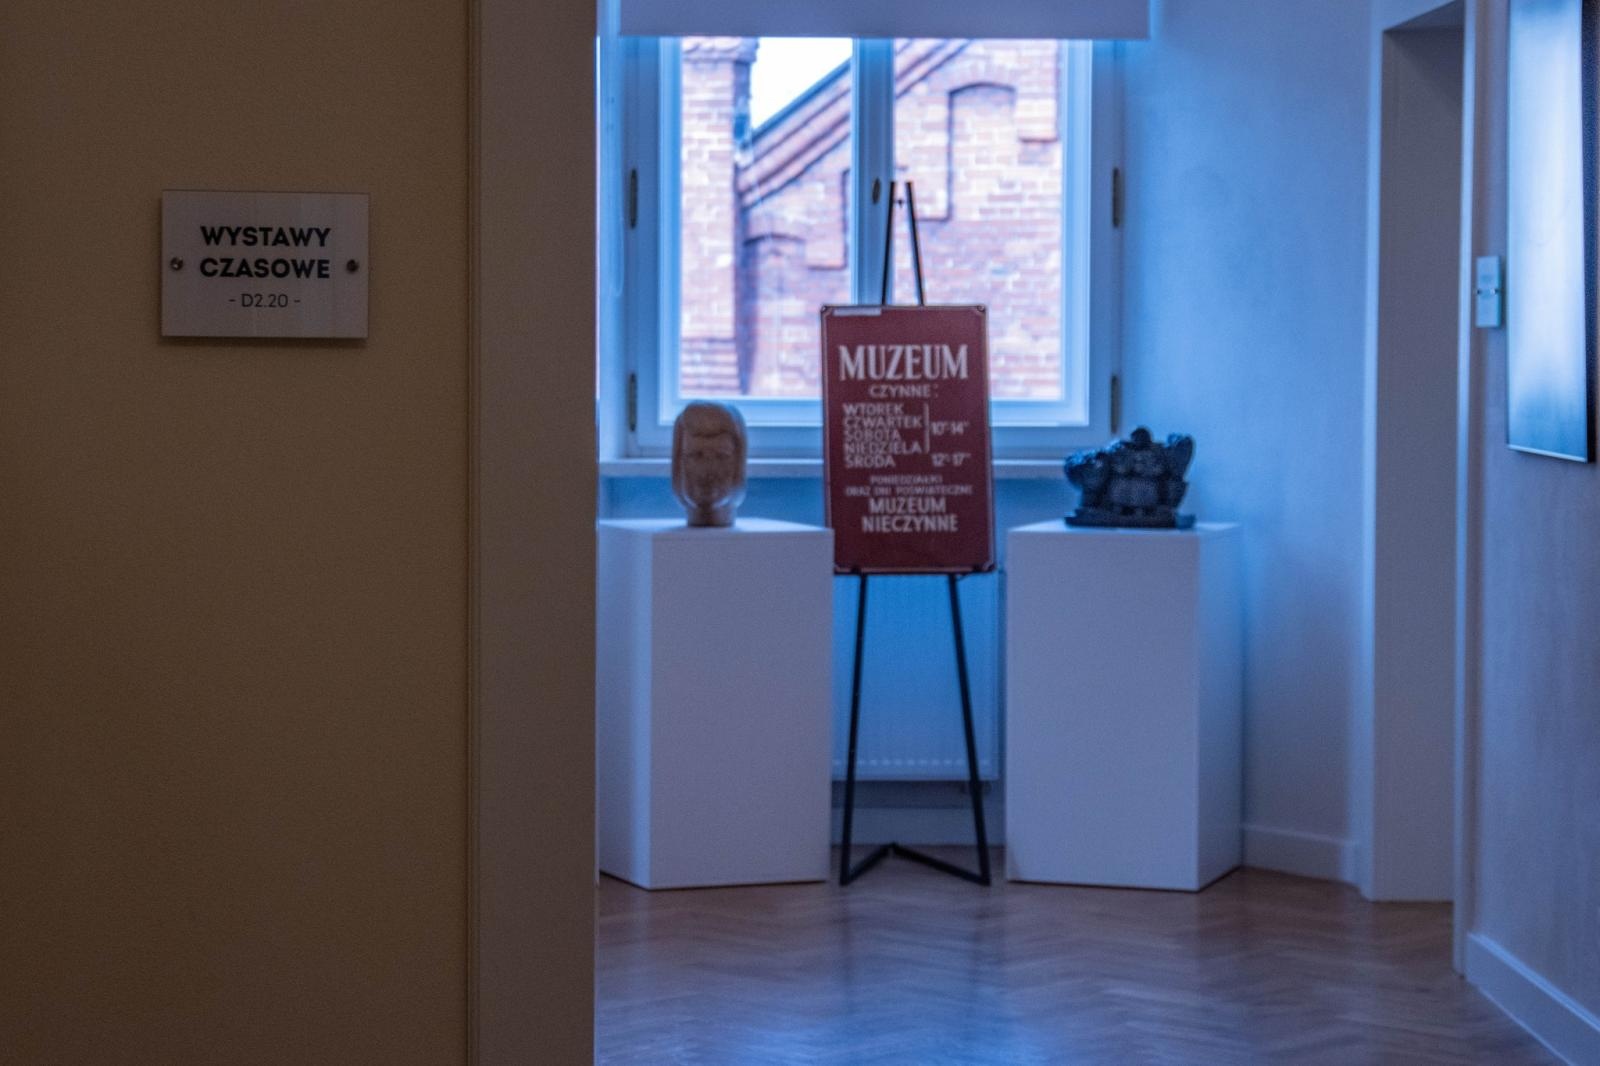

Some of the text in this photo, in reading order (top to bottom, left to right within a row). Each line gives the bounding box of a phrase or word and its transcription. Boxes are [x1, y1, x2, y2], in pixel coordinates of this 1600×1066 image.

[200, 226, 331, 247] WYSTAWY
[200, 257, 330, 279] CZASOWE
[241, 293, 289, 308] D2.20
[838, 344, 968, 381] MUZEUM
[842, 403, 904, 416] WTOREK
[869, 497, 946, 513] MUZEUM
[861, 514, 958, 532] NIECZYNNE
